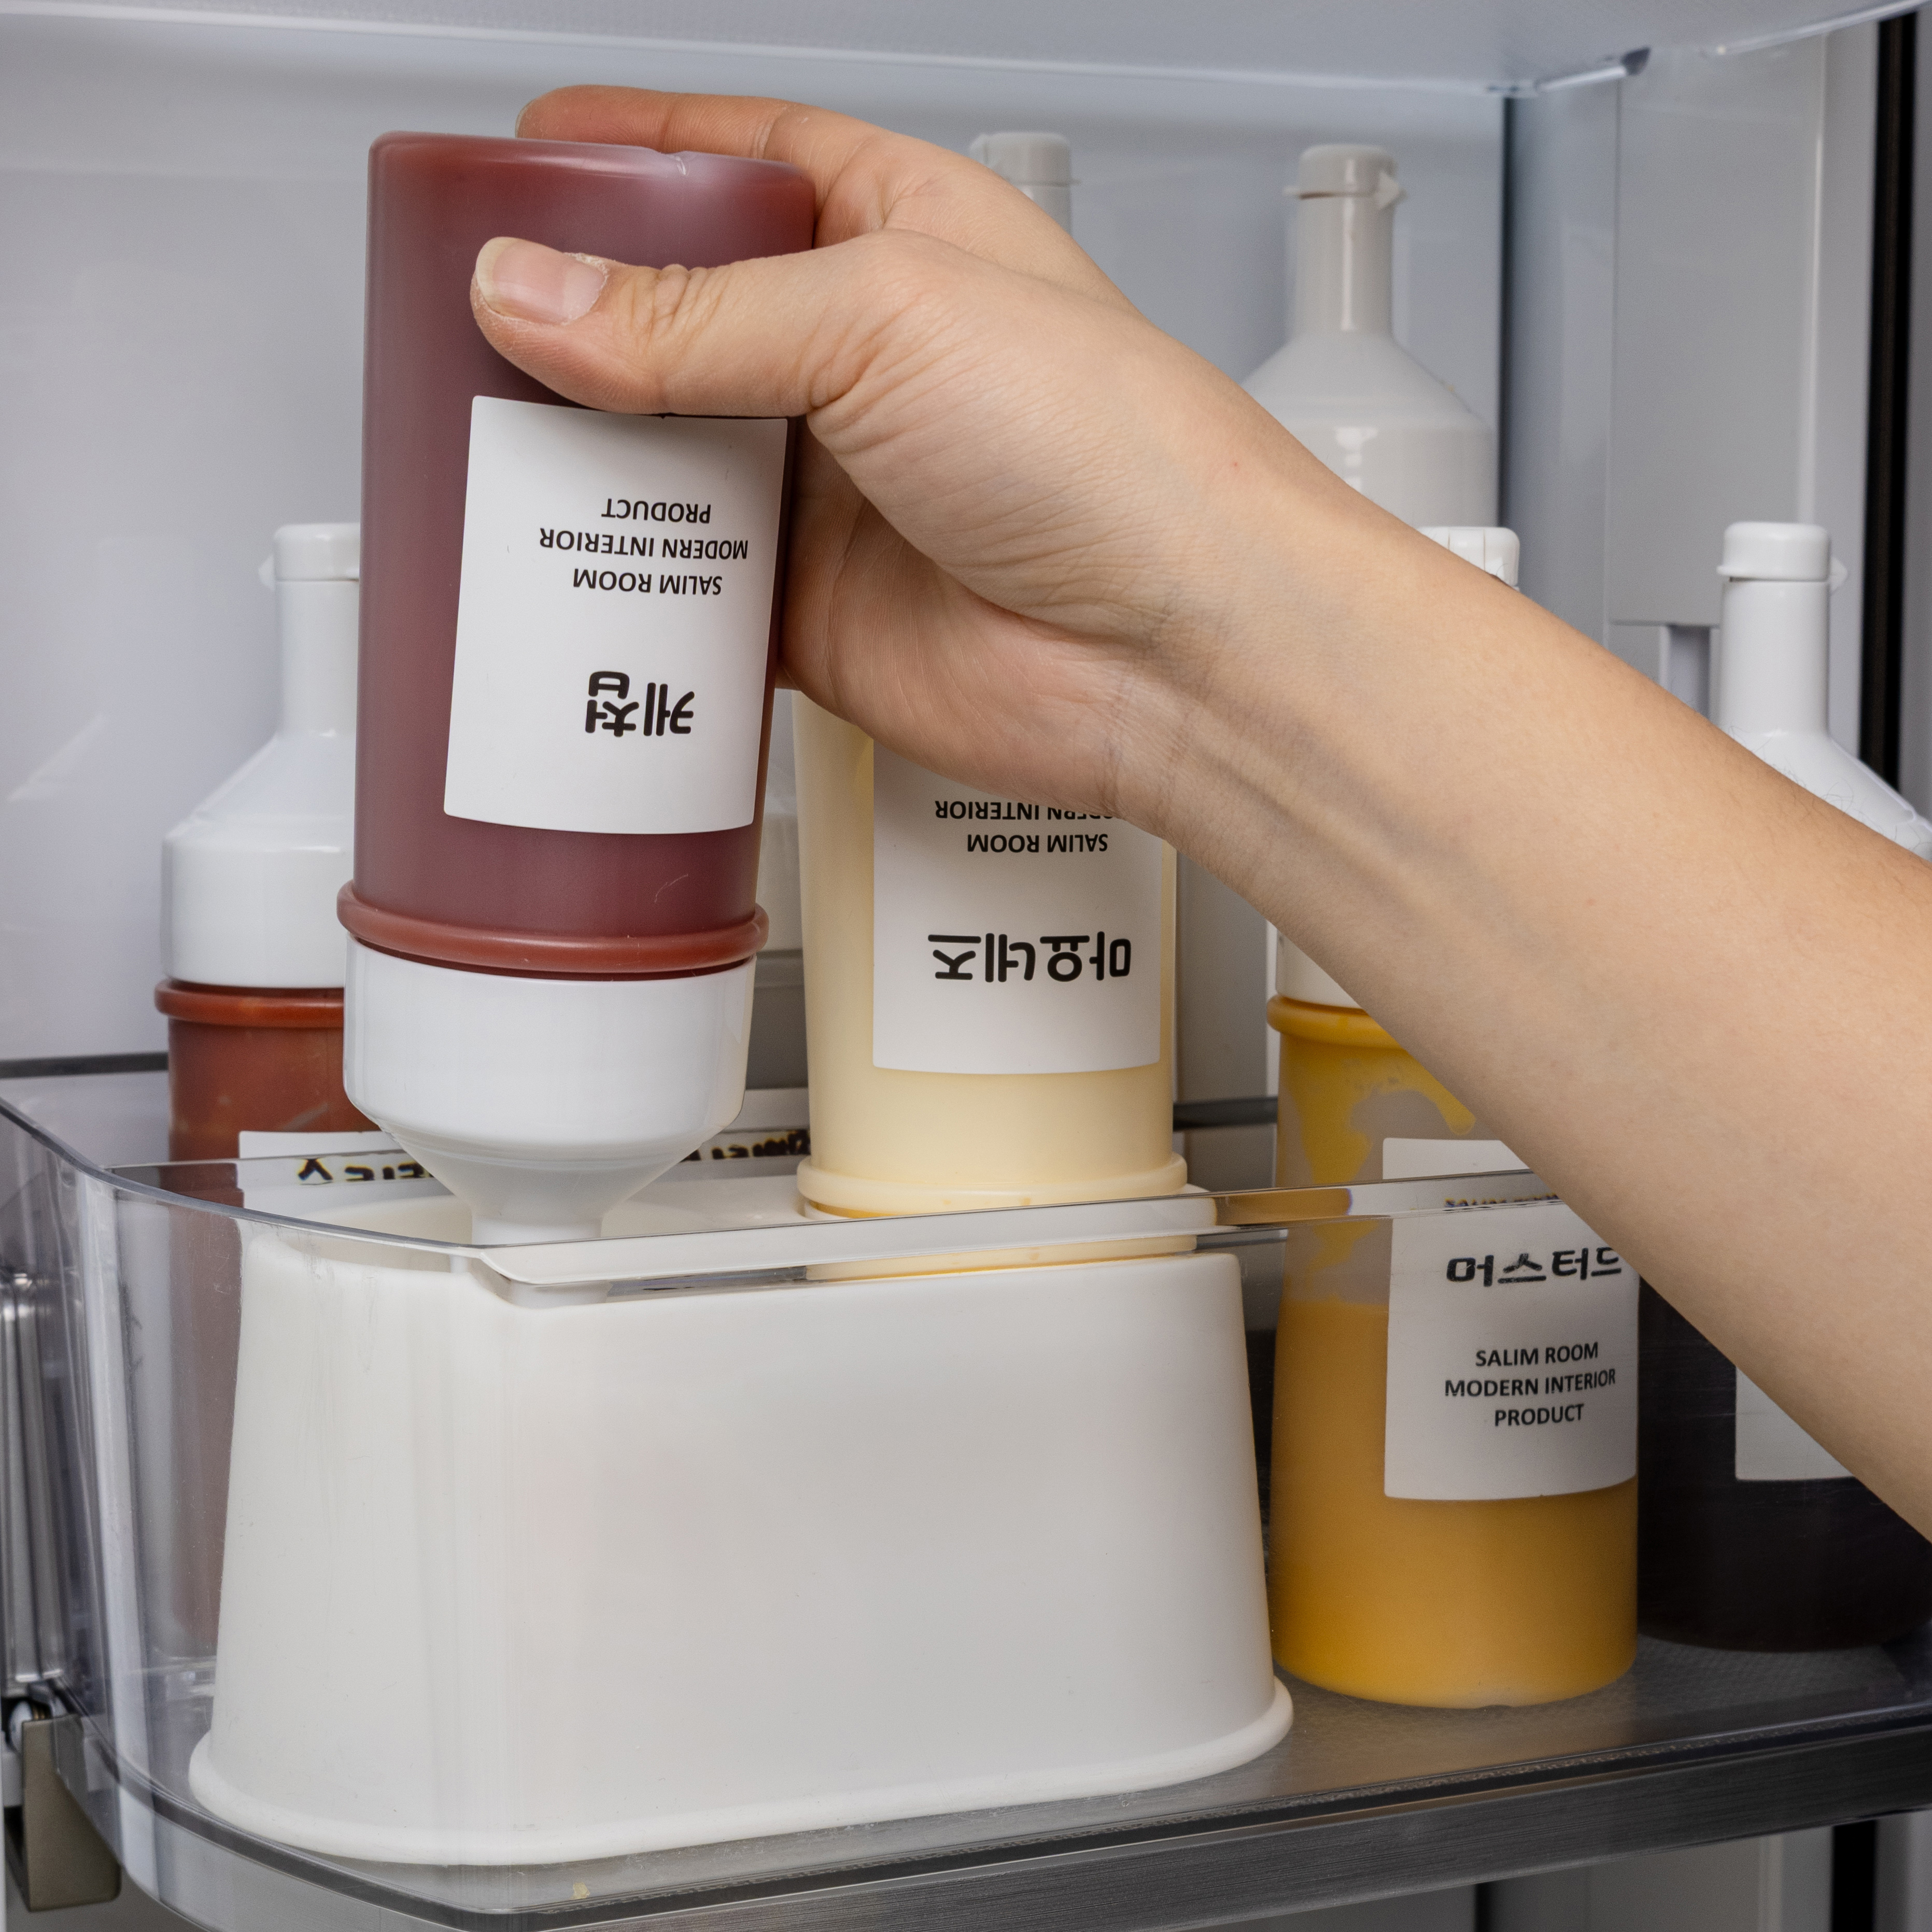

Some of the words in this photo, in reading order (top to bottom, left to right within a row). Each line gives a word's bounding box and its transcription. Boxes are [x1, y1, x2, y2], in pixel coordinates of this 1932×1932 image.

[601, 498, 711, 524] PRODUCT
[540, 528, 655, 557] INTERIOR
[662, 539, 749, 560] MODERN
[573, 568, 652, 593] ROOM
[659, 574, 723, 596] SALIM
[585, 671, 695, 738] 케첩
[935, 800, 1039, 820] INTERIOR
[967, 834, 1040, 853] ROOM
[1047, 833, 1108, 853] SALIM
[927, 930, 1132, 983] 마요네즈
[1446, 1246, 1622, 1287] 머스터드
[1475, 1347, 1539, 1367] SALIM
[1545, 1341, 1598, 1364] ROOM
[1445, 1377, 1539, 1397] MODERN
[1545, 1368, 1616, 1394] INTERIOR
[1494, 1402, 1585, 1427] PRODUCT
